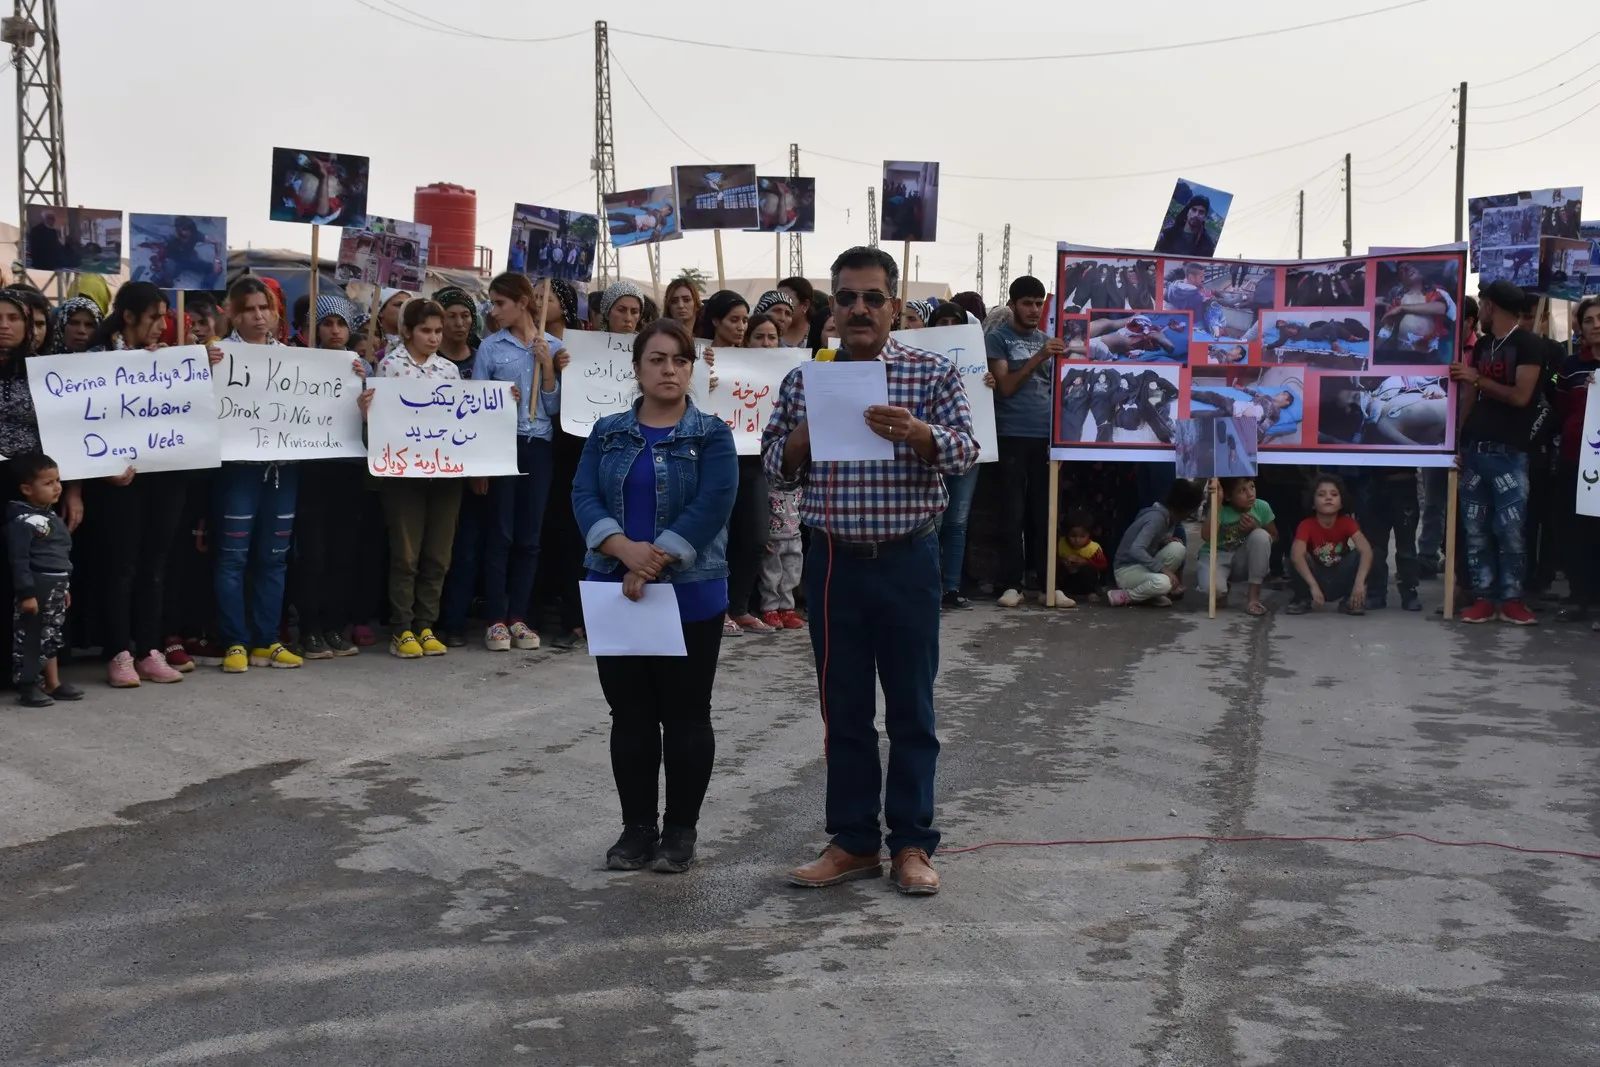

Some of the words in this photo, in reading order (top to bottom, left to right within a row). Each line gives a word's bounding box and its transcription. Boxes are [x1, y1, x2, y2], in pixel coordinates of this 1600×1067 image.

[227, 353, 250, 388] Li
[265, 357, 342, 398] Kobanê
[84, 397, 107, 421] Li
[120, 393, 192, 419] Kobanê
[399, 384, 456, 414] يكتب
[455, 387, 504, 420] التاريخ
[732, 380, 770, 409] صرخة
[217, 396, 260, 420] Dîrok
[268, 402, 287, 423] Ji
[289, 406, 311, 425] Nû
[317, 415, 333, 426] ve
[83, 433, 138, 460] Deng
[250, 426, 270, 448] Tê
[405, 426, 448, 443] جديد
[451, 429, 478, 446] من
[373, 442, 409, 476] كوباني
[414, 448, 464, 475] بمقاومة
